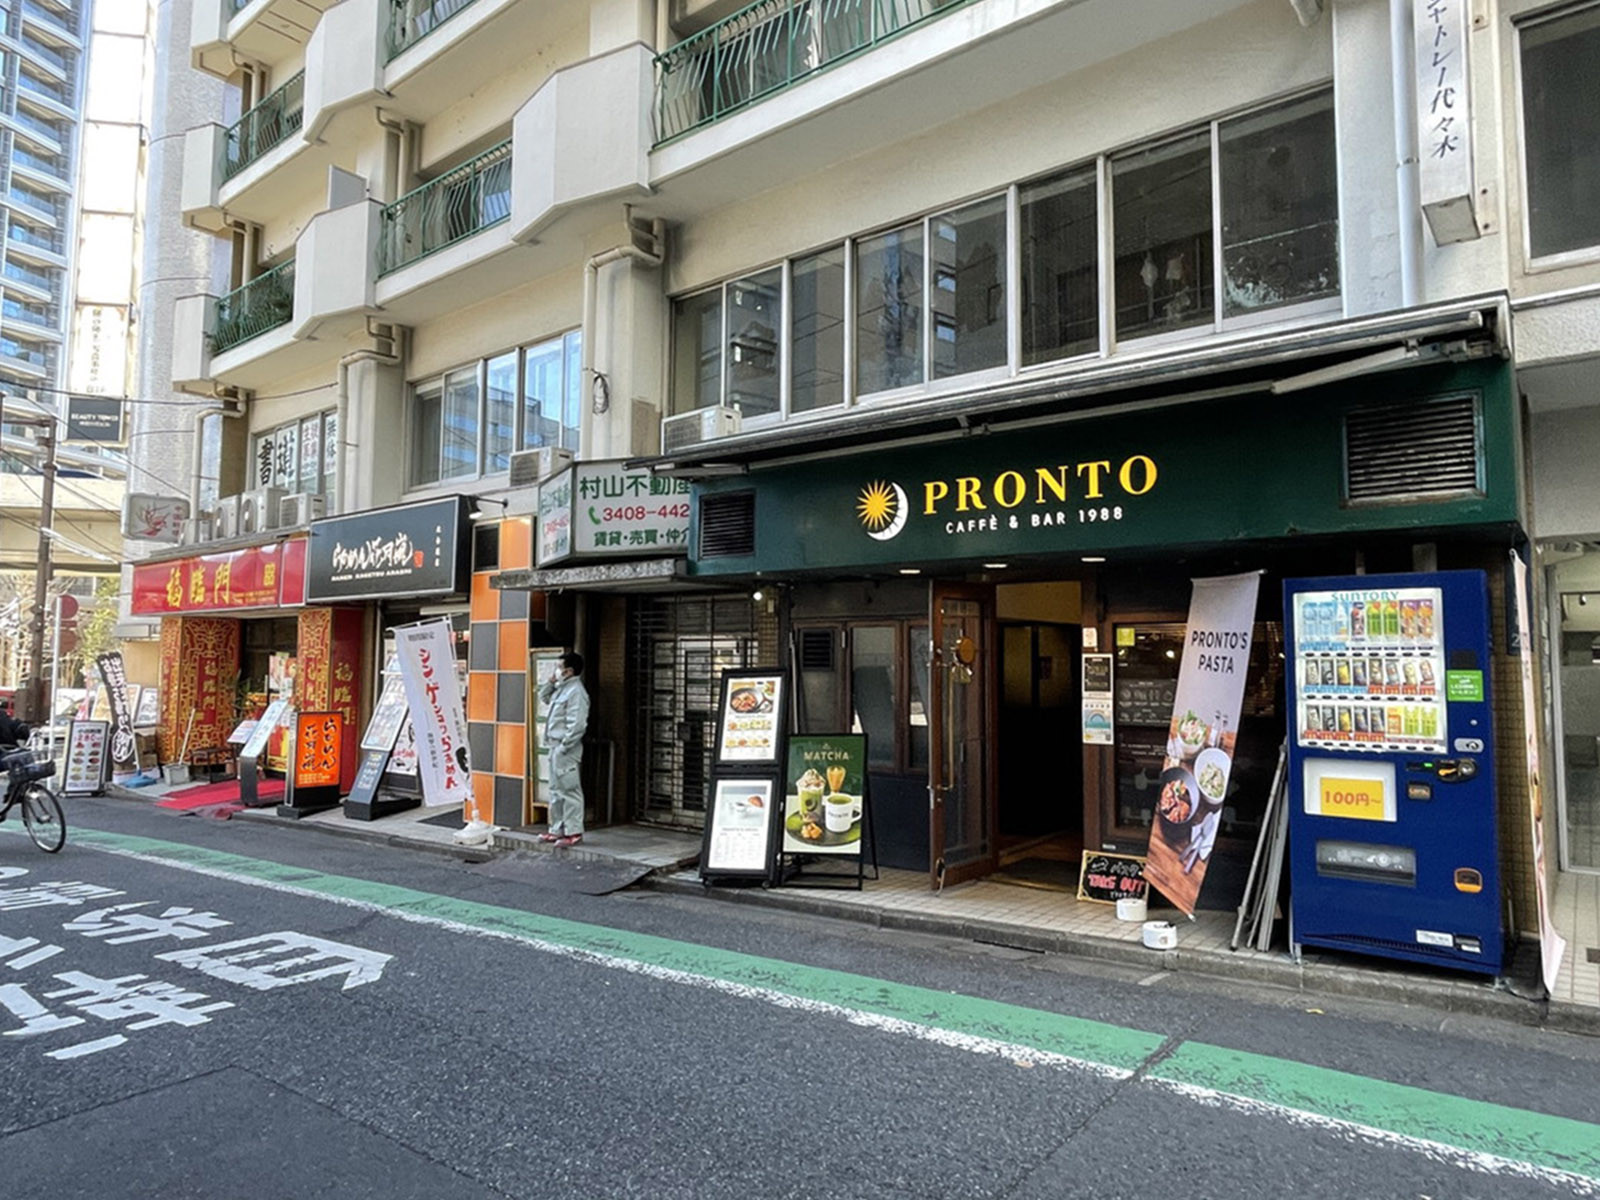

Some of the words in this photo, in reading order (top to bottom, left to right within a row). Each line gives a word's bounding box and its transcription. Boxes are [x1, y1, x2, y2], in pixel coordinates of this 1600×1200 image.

[923, 455, 1158, 515] PRONTO
[945, 514, 998, 534] CAFFÈ
[1008, 515, 1019, 529] &
[1031, 511, 1067, 527] BAR
[1078, 506, 1123, 523] 1988
[166, 562, 231, 608] 福臨門
[1331, 591, 1399, 601] SUNTORY
[1191, 630, 1248, 651] PRONTO'S
[1198, 654, 1234, 674] PASTA
[804, 751, 849, 760] MATCHA
[1120, 877, 1145, 892] OUT
